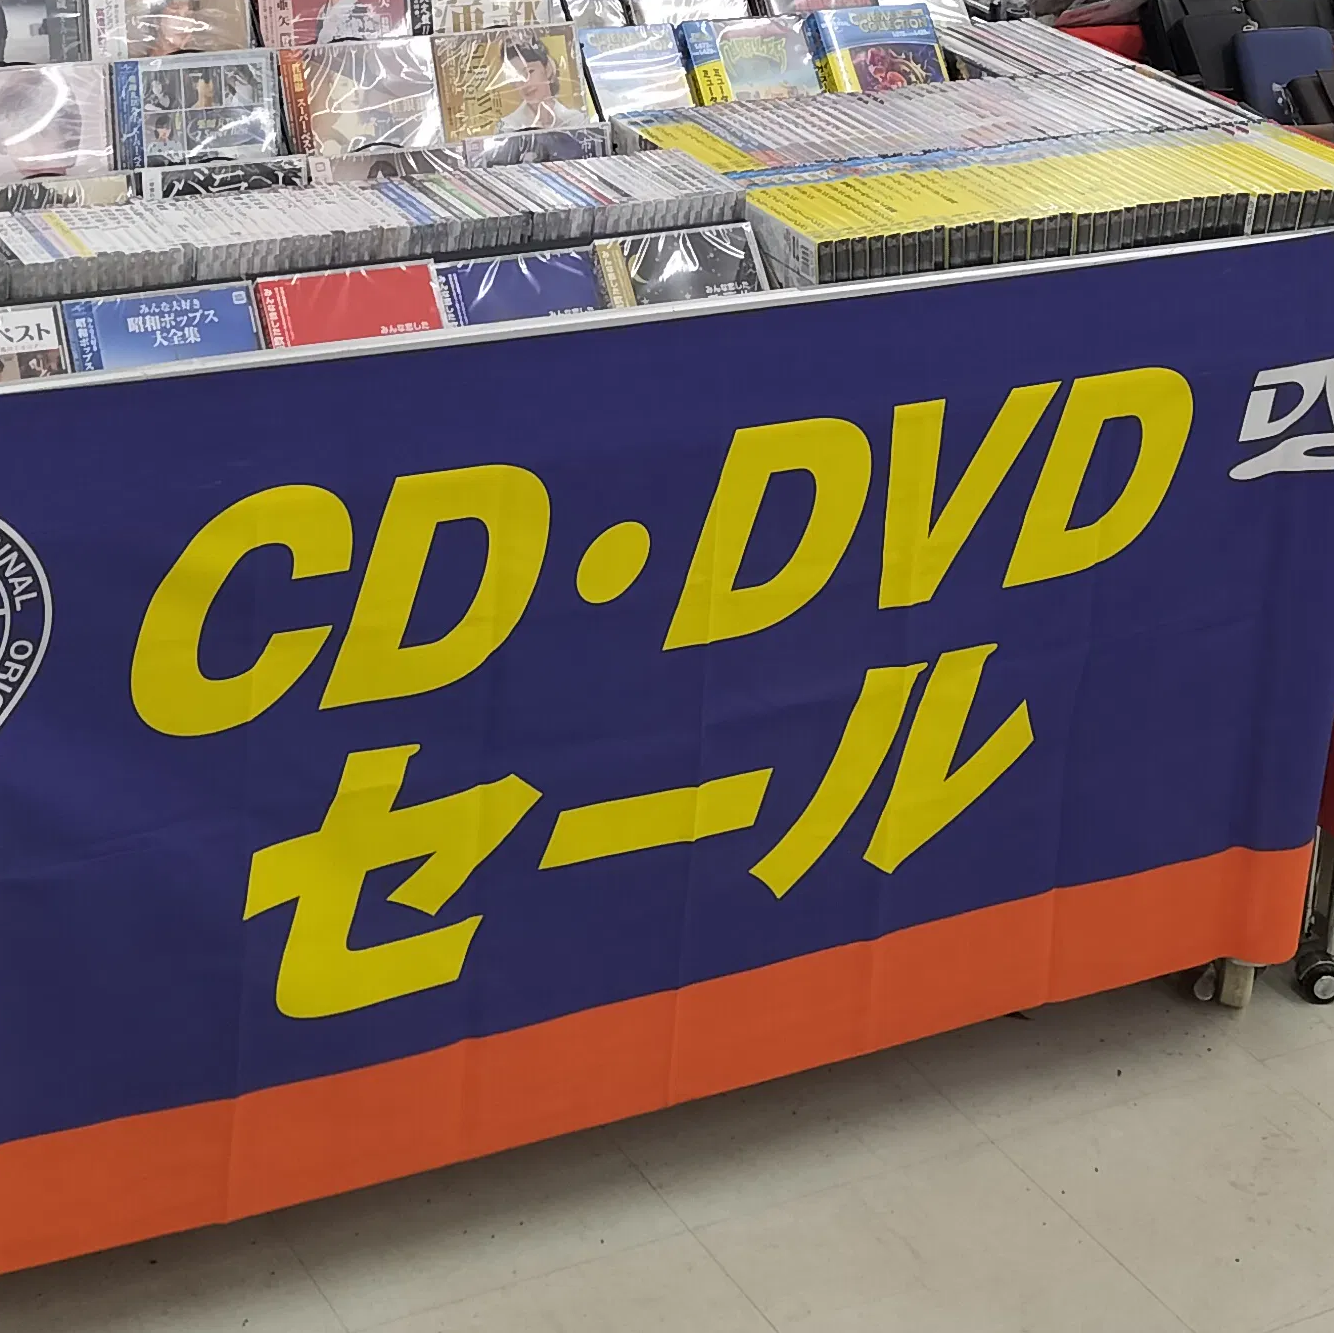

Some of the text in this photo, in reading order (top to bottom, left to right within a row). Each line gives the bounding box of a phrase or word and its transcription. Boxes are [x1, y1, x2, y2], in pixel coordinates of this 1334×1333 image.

[127, 311, 220, 332] 昭和ポップス
[151, 327, 202, 347] 大全集
[129, 366, 1194, 739] CD・DVD
[242, 643, 1036, 1019] セール
